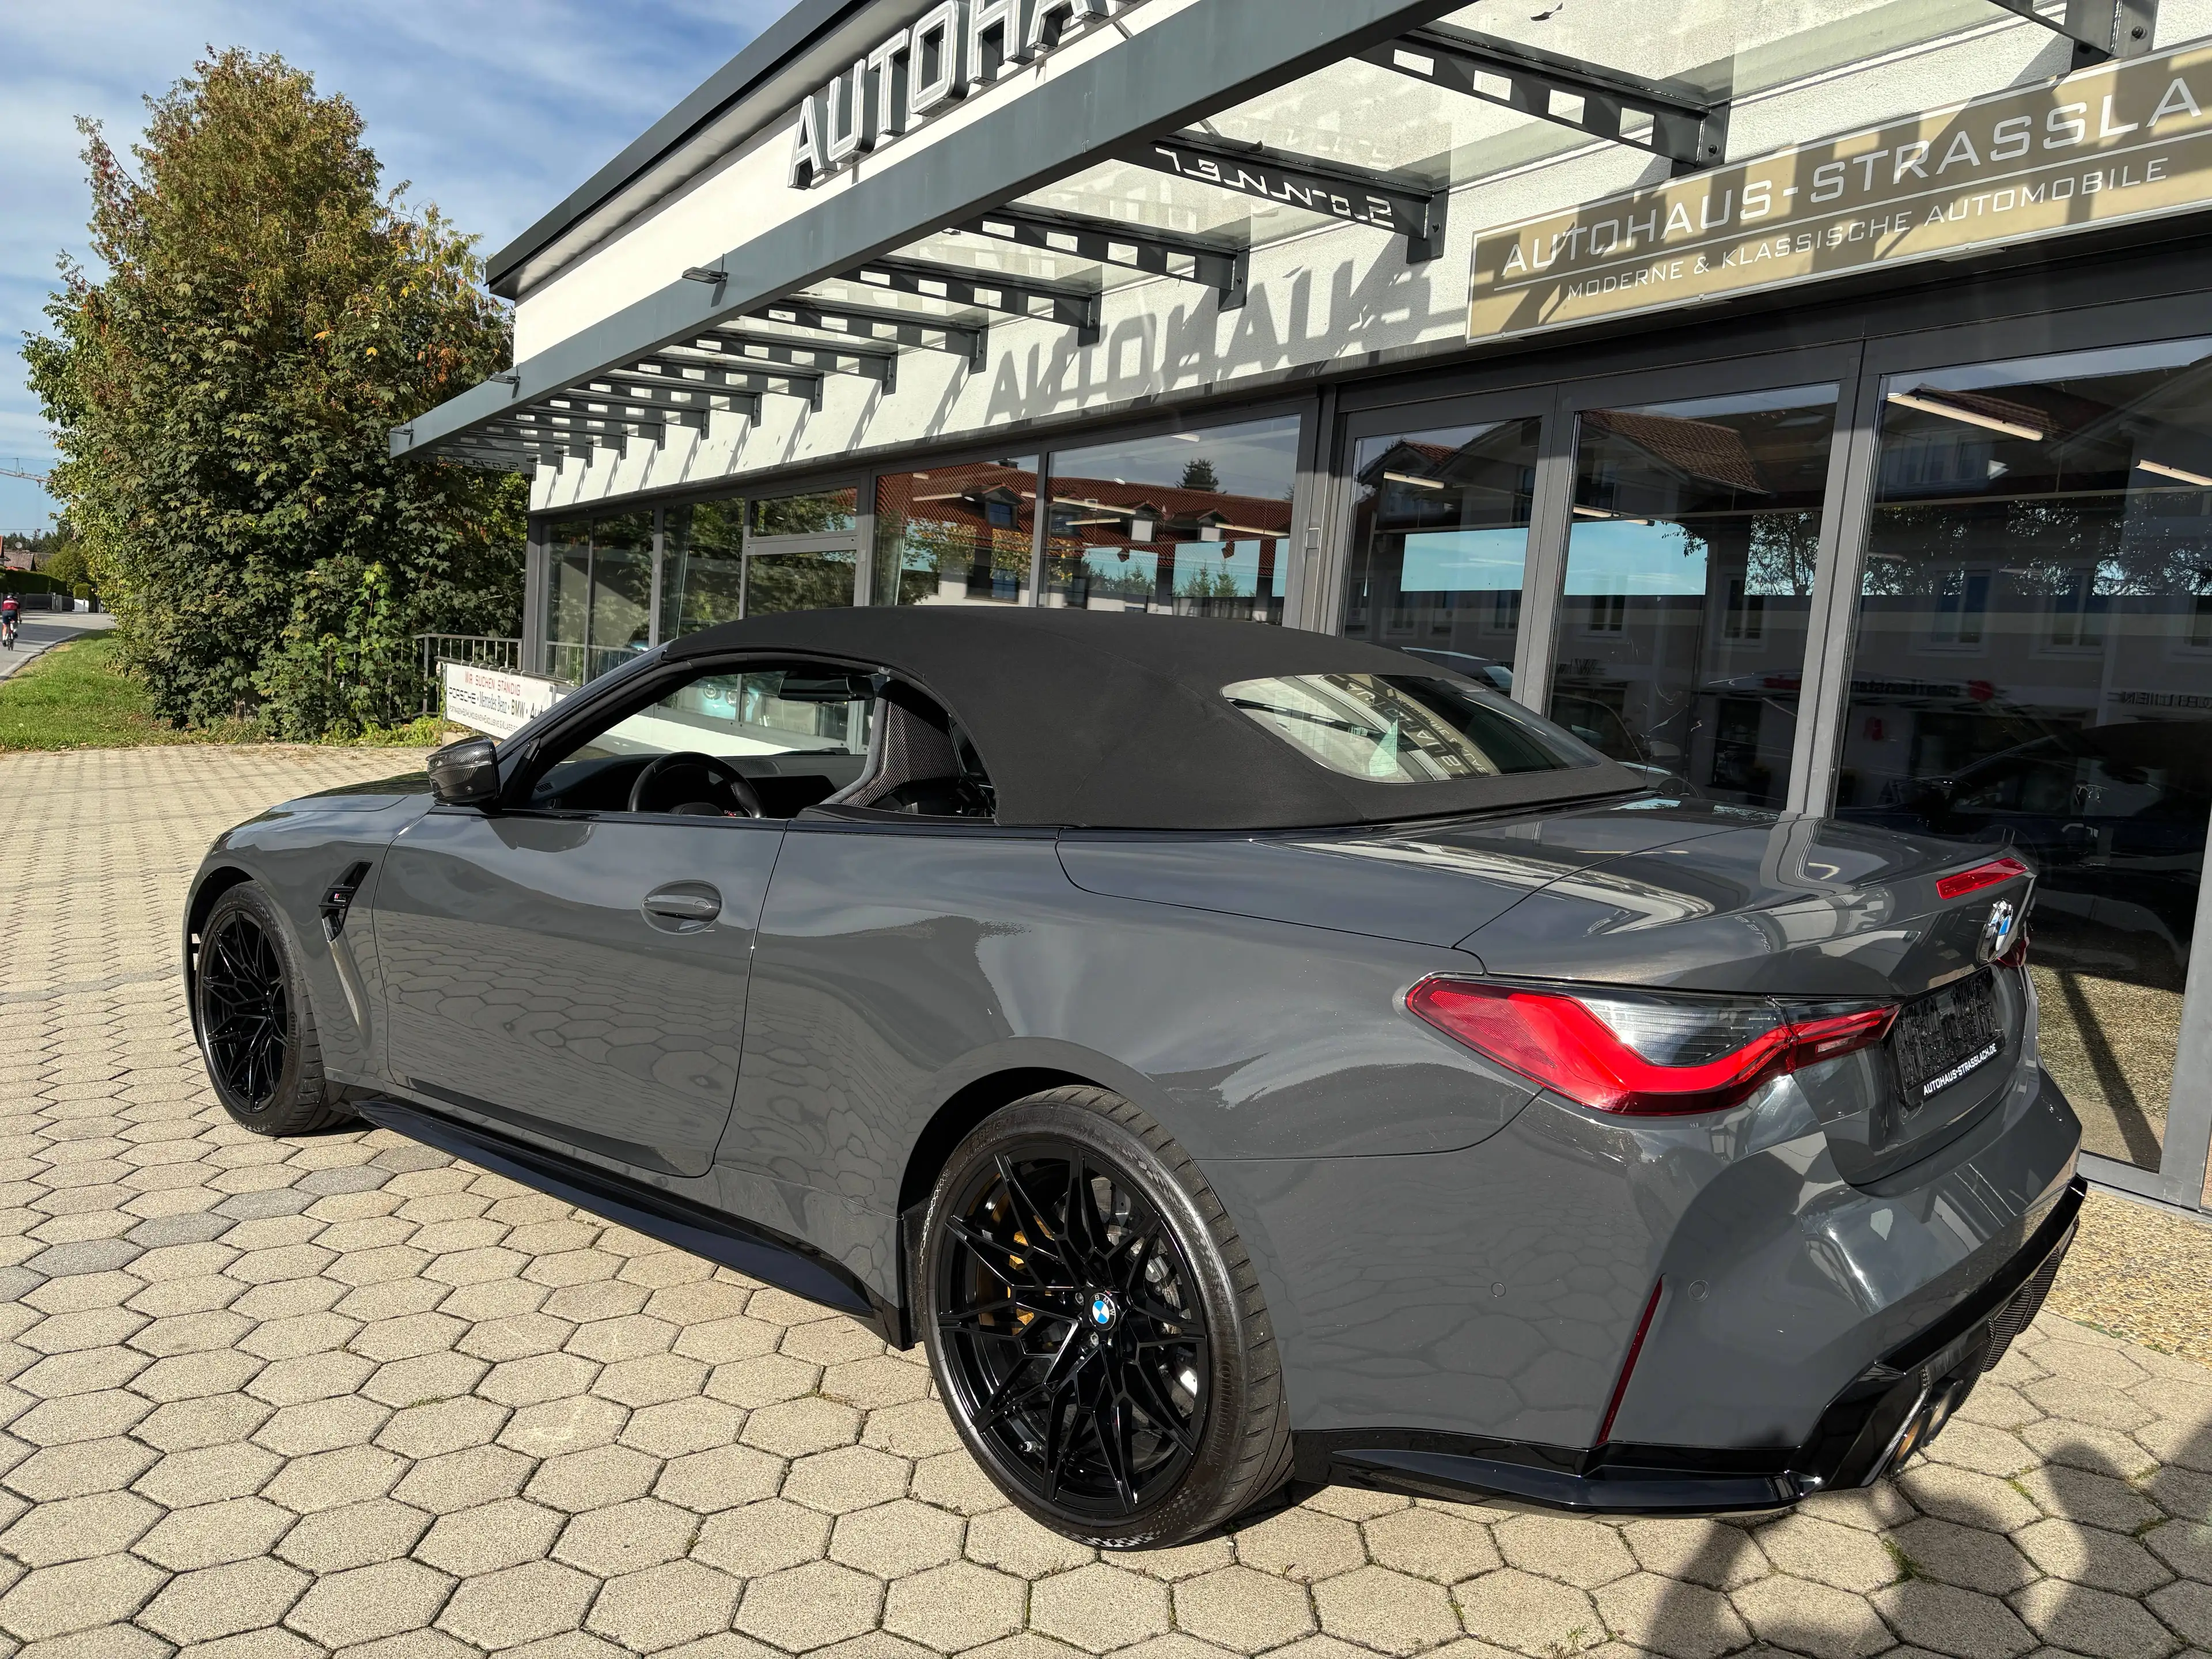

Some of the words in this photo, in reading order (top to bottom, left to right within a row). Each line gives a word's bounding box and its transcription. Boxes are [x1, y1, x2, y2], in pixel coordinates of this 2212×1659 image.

[1500, 77, 2202, 277] AUTOHAUS-STRASSLA
[1567, 259, 1683, 301] MODERNE
[1693, 256, 1710, 276] &
[1721, 210, 1913, 270] KLASSISCHE
[1923, 156, 2169, 227] AUTOMOBILE
[475, 675, 495, 690] SUCHEN
[449, 687, 476, 704] PORSCHE
[511, 699, 525, 719] BMW
[1094, 1294, 1115, 1316] BMW
